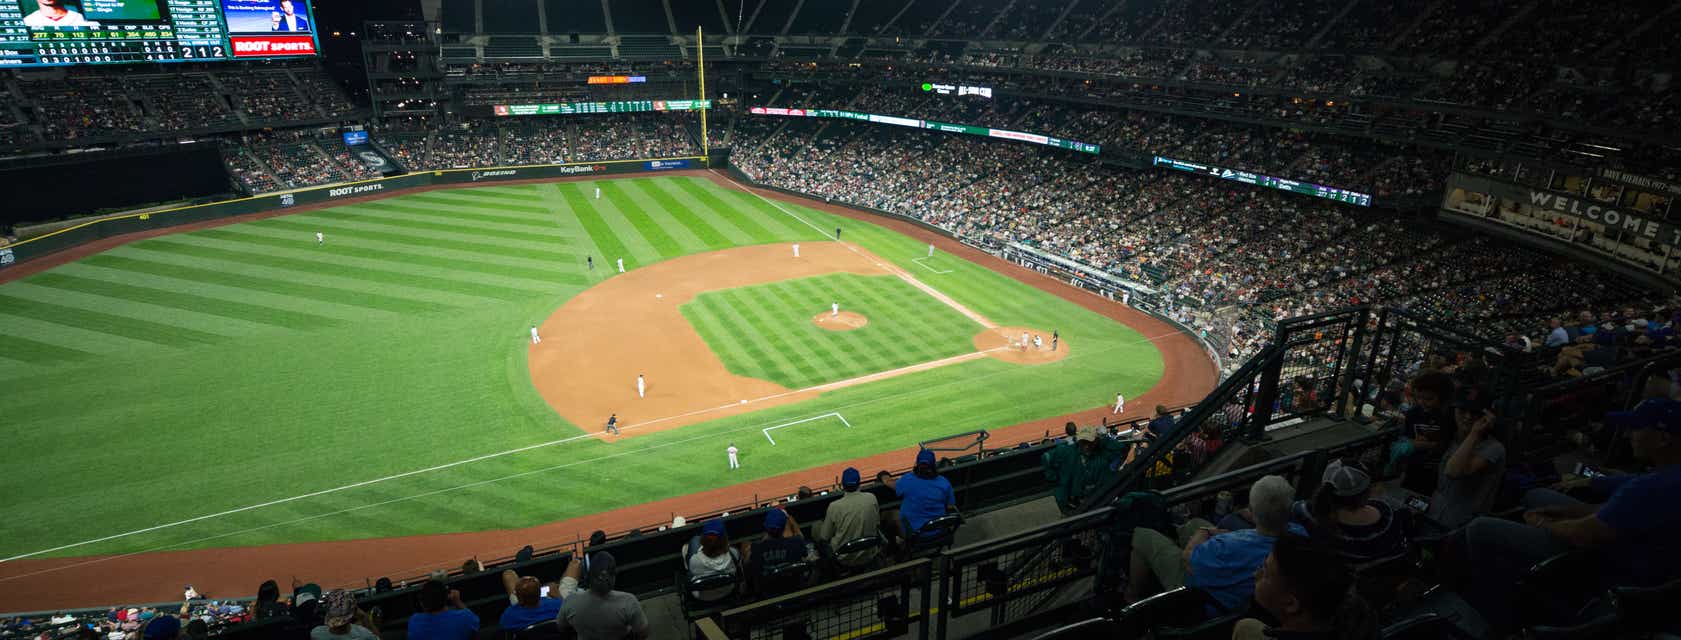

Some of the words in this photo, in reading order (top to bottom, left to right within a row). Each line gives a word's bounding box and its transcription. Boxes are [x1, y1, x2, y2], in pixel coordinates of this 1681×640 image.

[235, 41, 270, 51] ROOT
[183, 48, 192, 57] 2
[199, 47, 206, 57] 1
[213, 47, 222, 56] 2
[561, 165, 593, 175] KeyBank
[330, 187, 353, 197] ROOT
[354, 184, 382, 193] SPORTS
[1529, 191, 1659, 239] WELCOME
